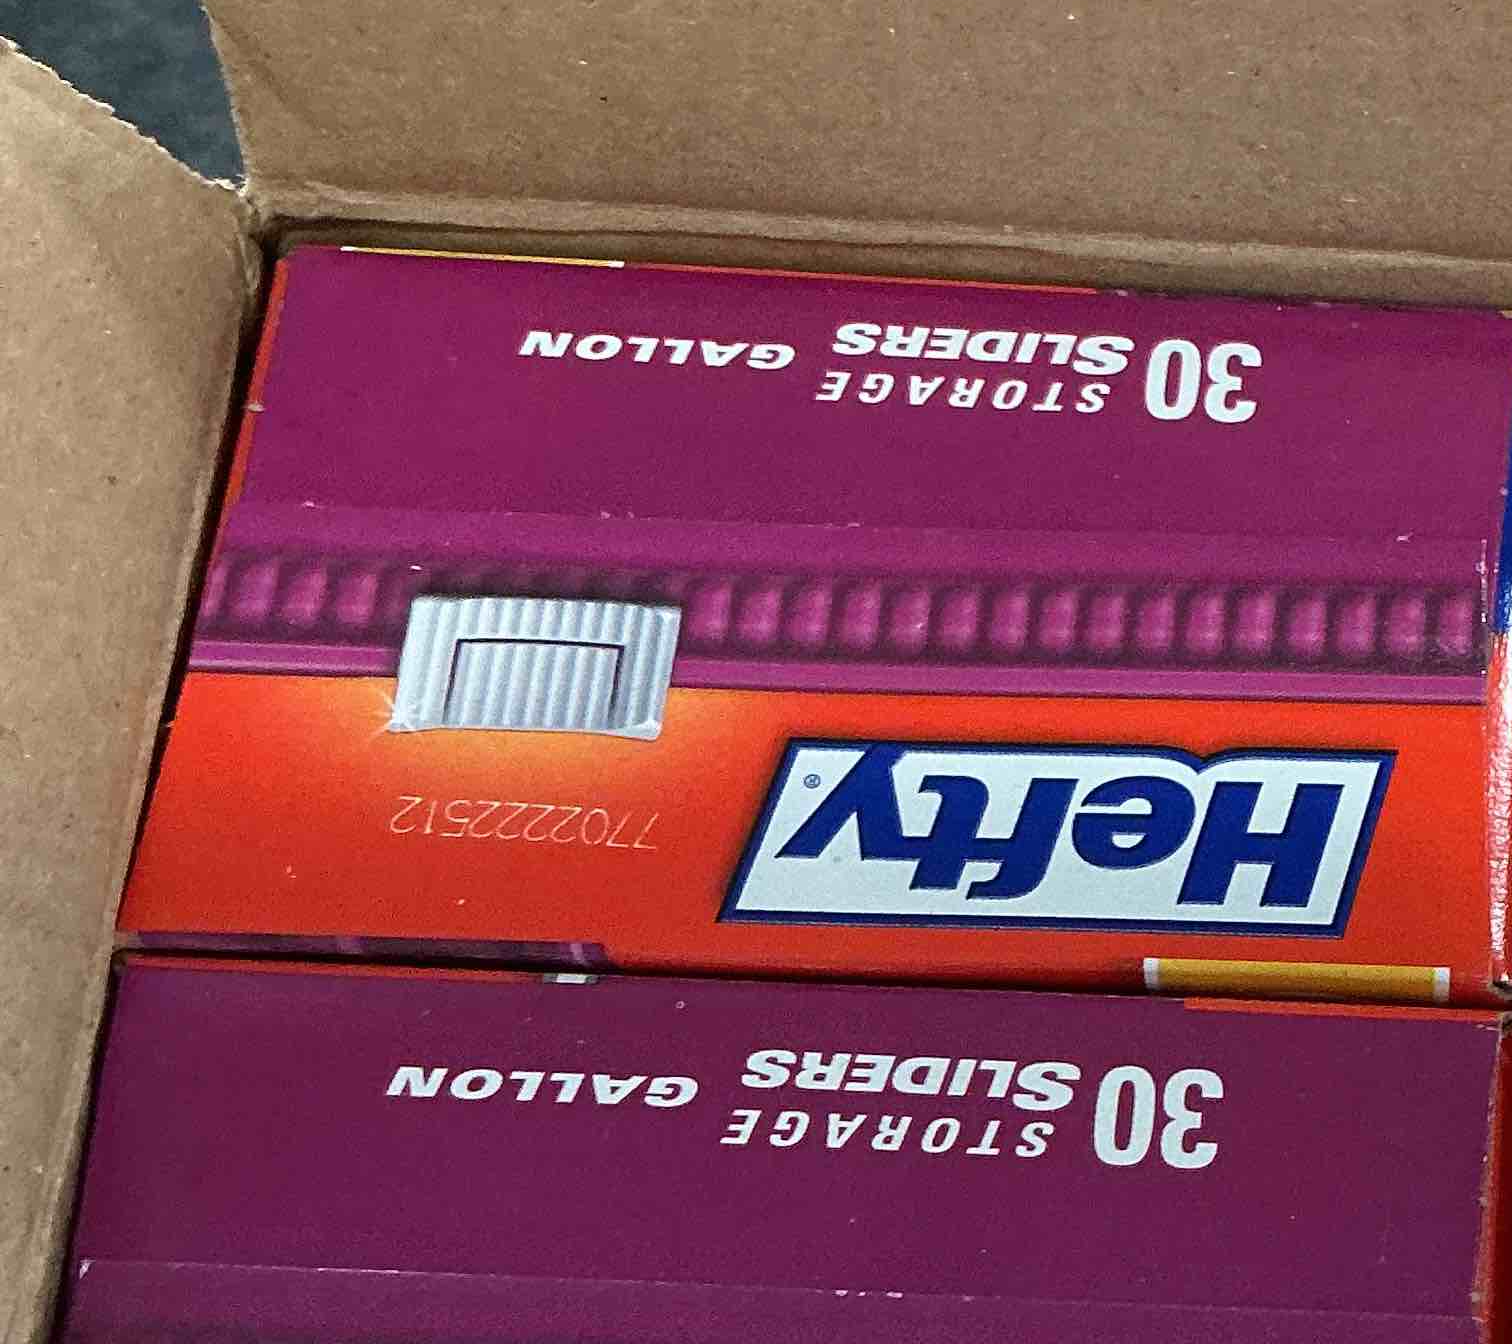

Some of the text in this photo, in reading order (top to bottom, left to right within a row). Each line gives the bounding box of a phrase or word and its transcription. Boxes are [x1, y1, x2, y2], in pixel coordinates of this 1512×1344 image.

[519, 323, 1134, 375] SLIDERS GALLON
[816, 371, 1110, 412] STORAGE
[1145, 339, 1261, 423] 30
[390, 795, 660, 850] 7702222512
[780, 746, 1342, 907] Hefty
[386, 1050, 1081, 1111] SLIDERS GALLON
[720, 1110, 1054, 1157] STORAGE
[1094, 1066, 1223, 1168] 30
